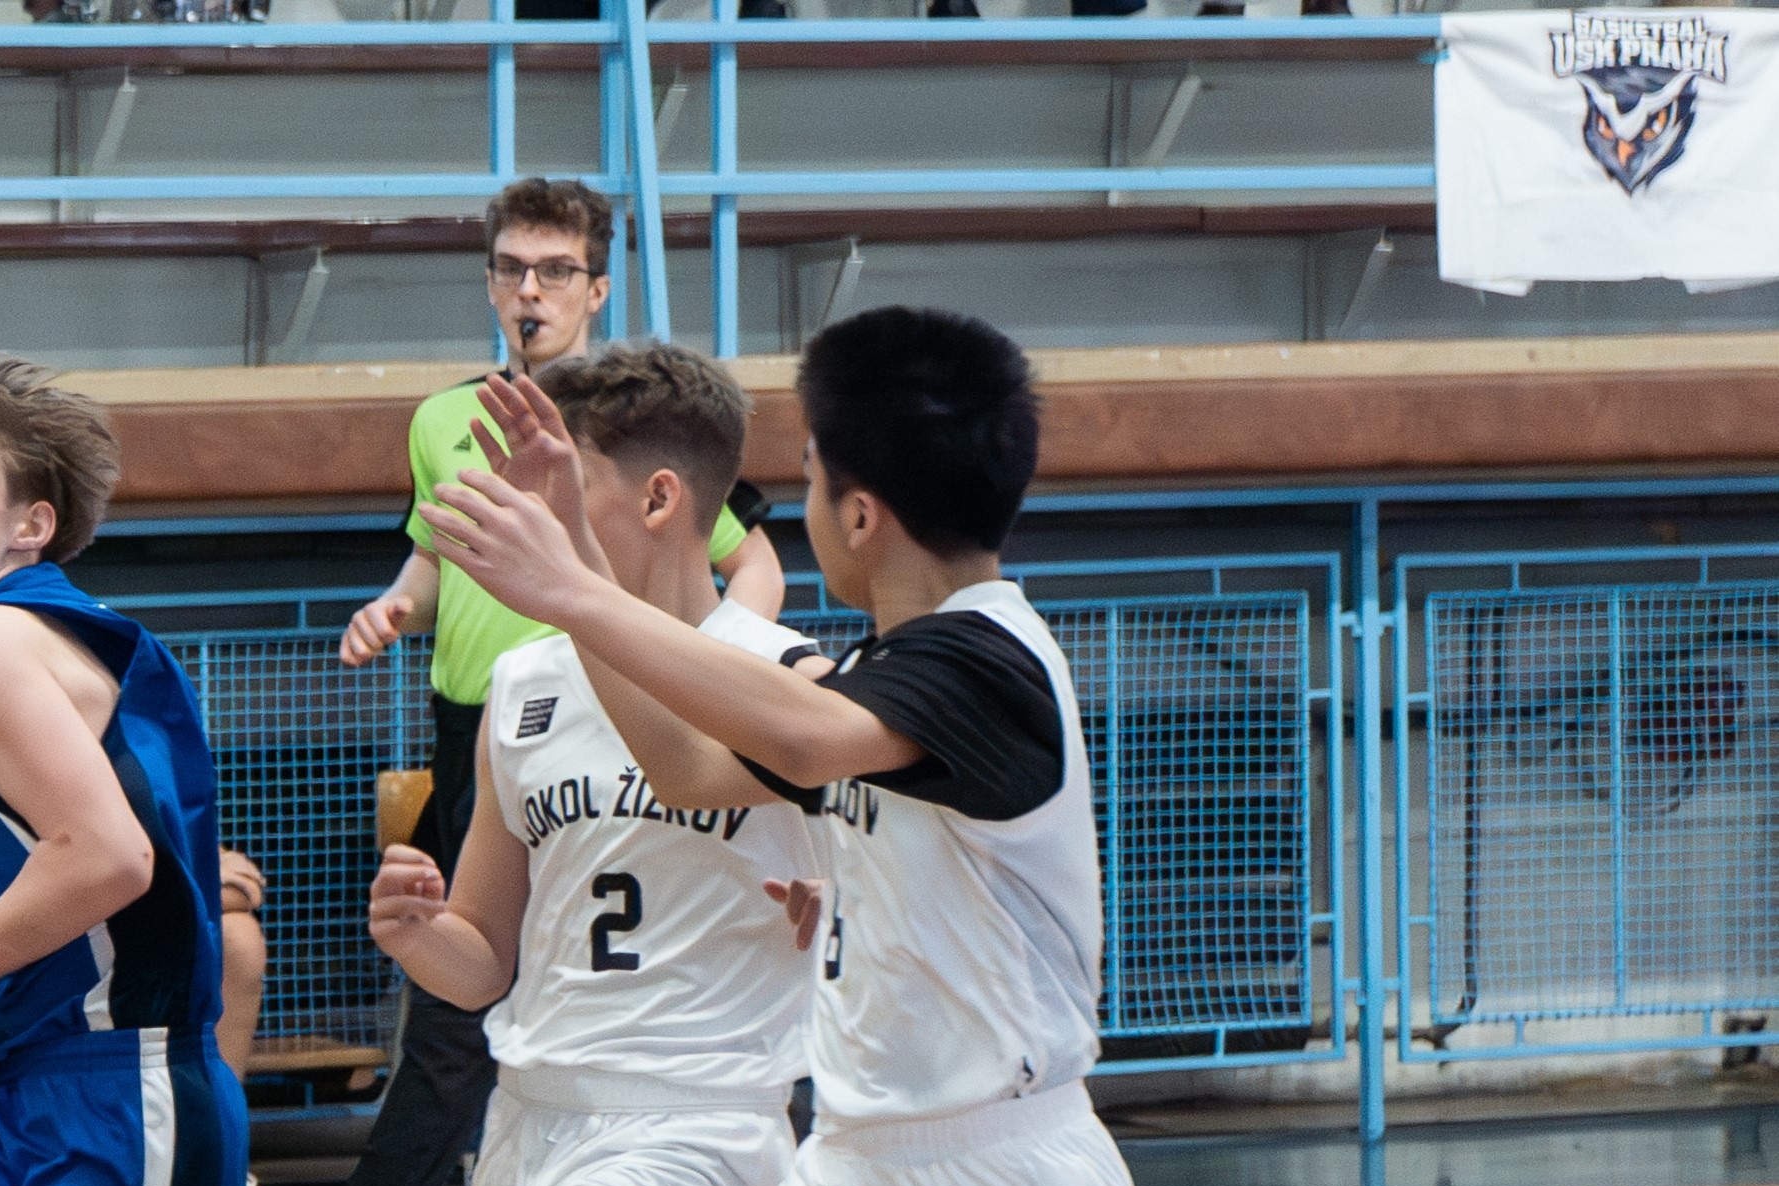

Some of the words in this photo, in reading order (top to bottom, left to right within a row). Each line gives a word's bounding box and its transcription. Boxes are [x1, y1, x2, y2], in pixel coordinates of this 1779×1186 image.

[1573, 16, 1707, 41] BASKETBAL
[1550, 31, 1616, 77] USK
[1619, 36, 1728, 83] PRAHA
[591, 872, 643, 972] 2
